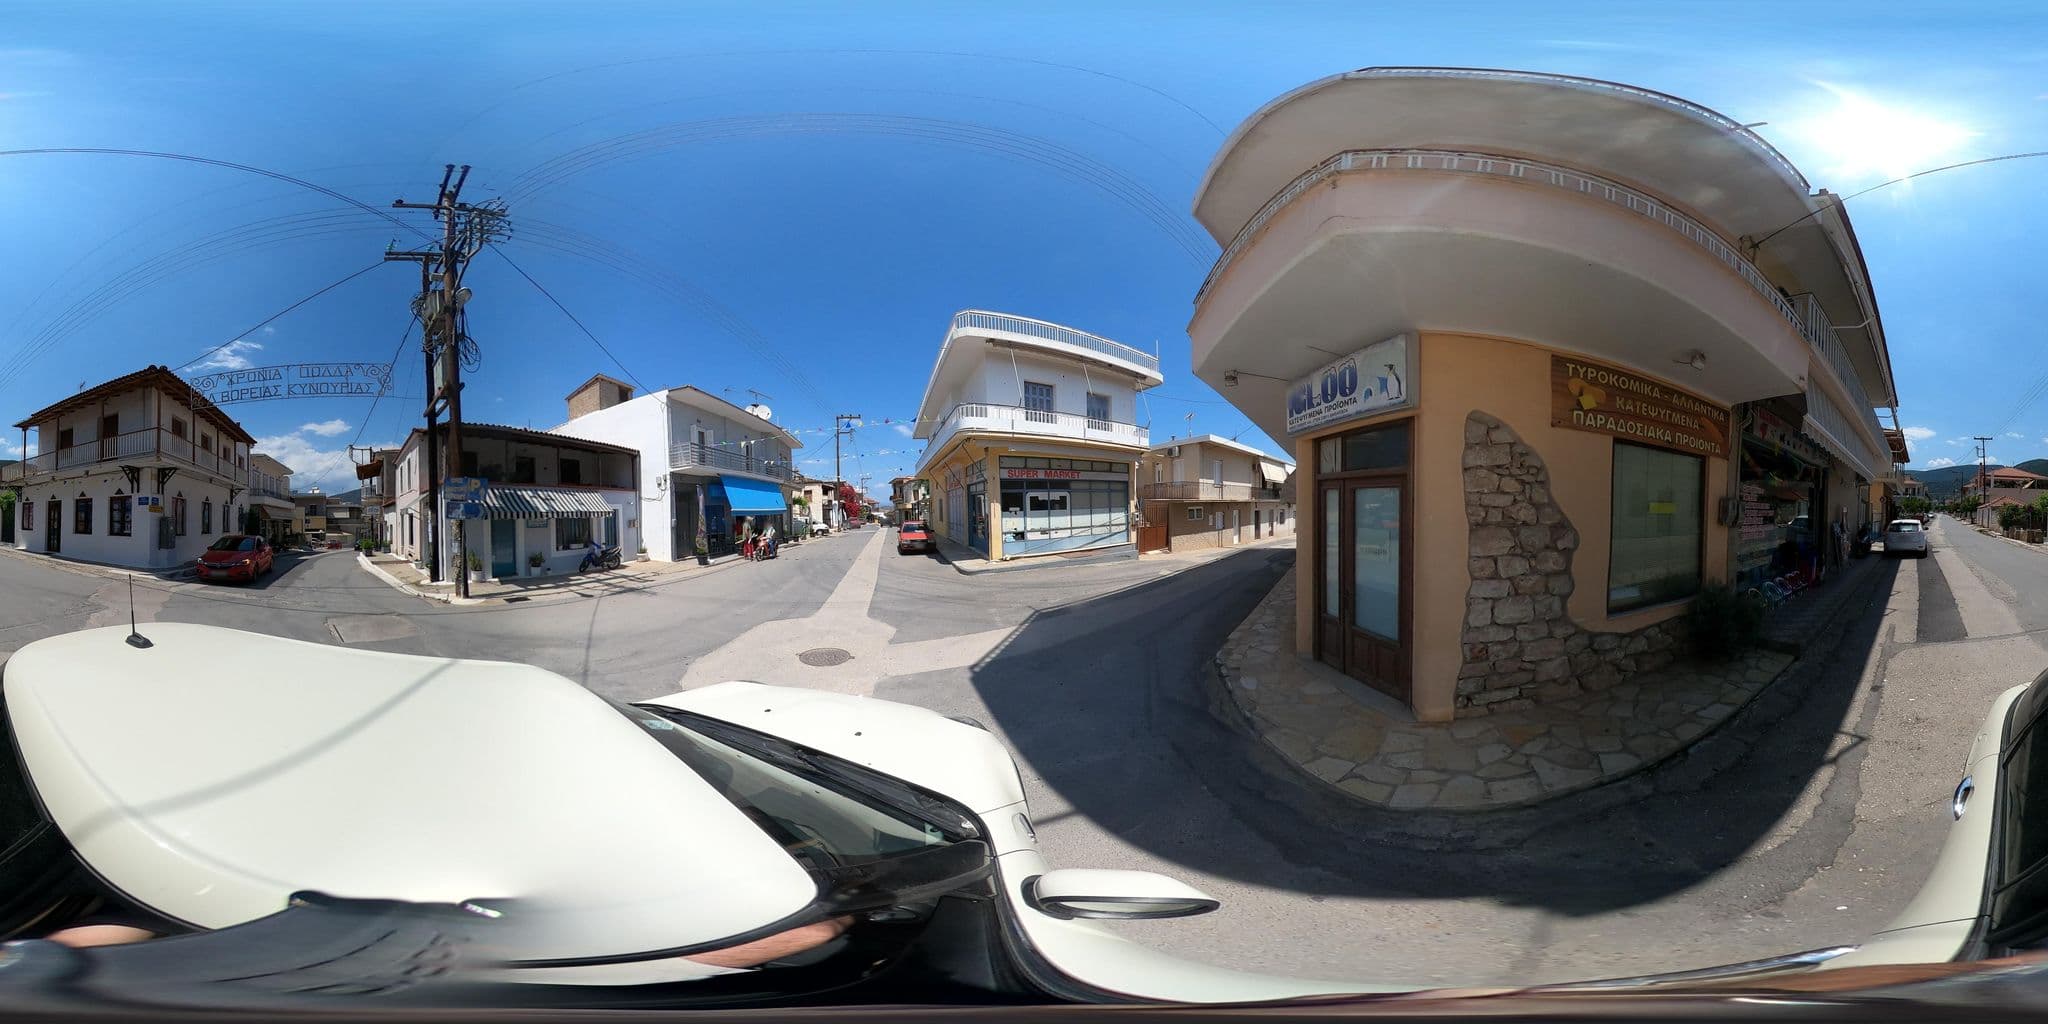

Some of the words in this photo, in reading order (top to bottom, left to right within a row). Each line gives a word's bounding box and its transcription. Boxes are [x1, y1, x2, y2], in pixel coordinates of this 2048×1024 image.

[227, 368, 282, 386] ΧΡΟΝΙΑ
[221, 385, 282, 403] ΒΟΡΕΙΑΣ
[288, 382, 374, 395] ΚΥΝΟΥΡΙΑΣ
[1566, 363, 1661, 399] ΤΥΡΟΚΟΜΙΚΑ
[1672, 394, 1725, 423] ΑΛΛΑΝΤΙΚΑ
[1573, 410, 1672, 442] ΠΑΡΑΔΟΣΙΑΚΑ
[1616, 396, 1700, 431] ΚΑΤΕΨΥΓΜΕΝΑ
[1007, 469, 1039, 478] SUPER
[1044, 470, 1081, 479] MARKET
